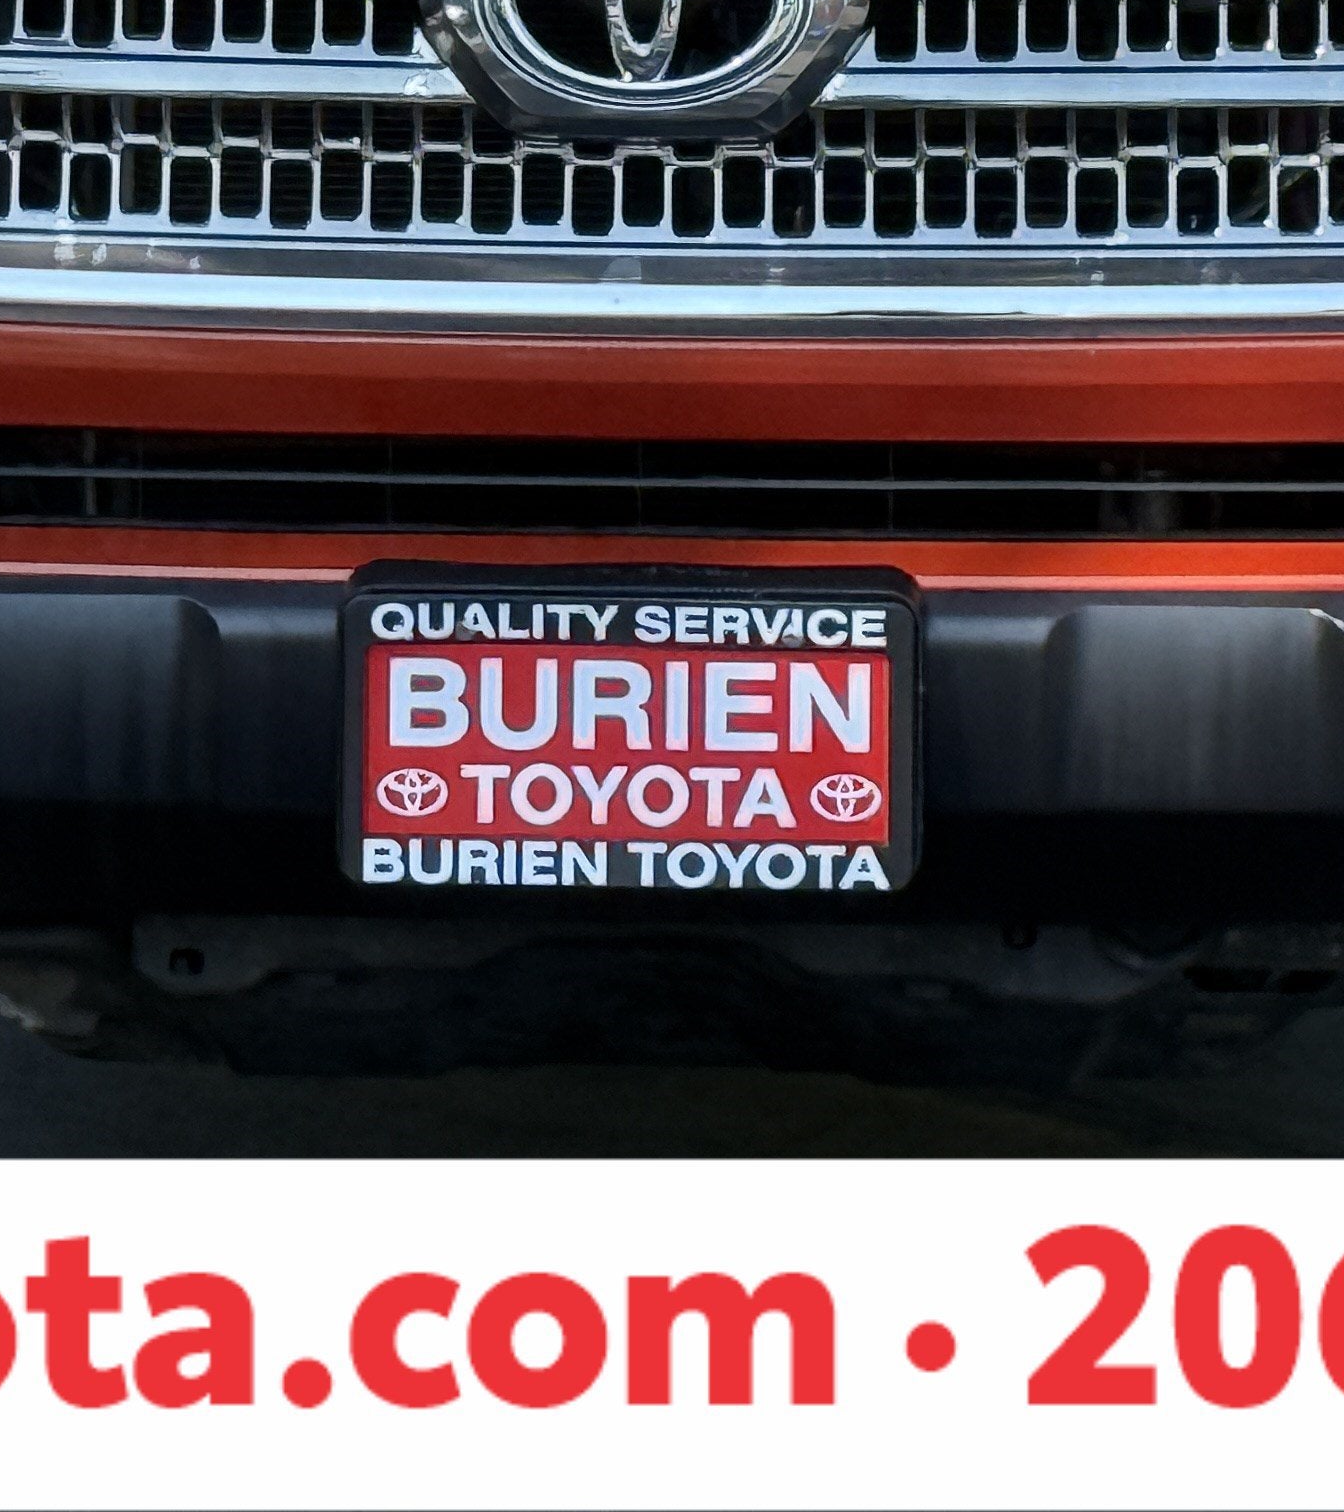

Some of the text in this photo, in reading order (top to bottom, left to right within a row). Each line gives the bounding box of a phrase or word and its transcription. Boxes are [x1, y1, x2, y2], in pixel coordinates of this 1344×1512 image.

[370, 601, 888, 648] QUALITY SERVICE
[388, 656, 872, 753] BURIEN
[459, 762, 797, 829] TOYOTA
[362, 838, 892, 890] BURIEN TOYOTA
